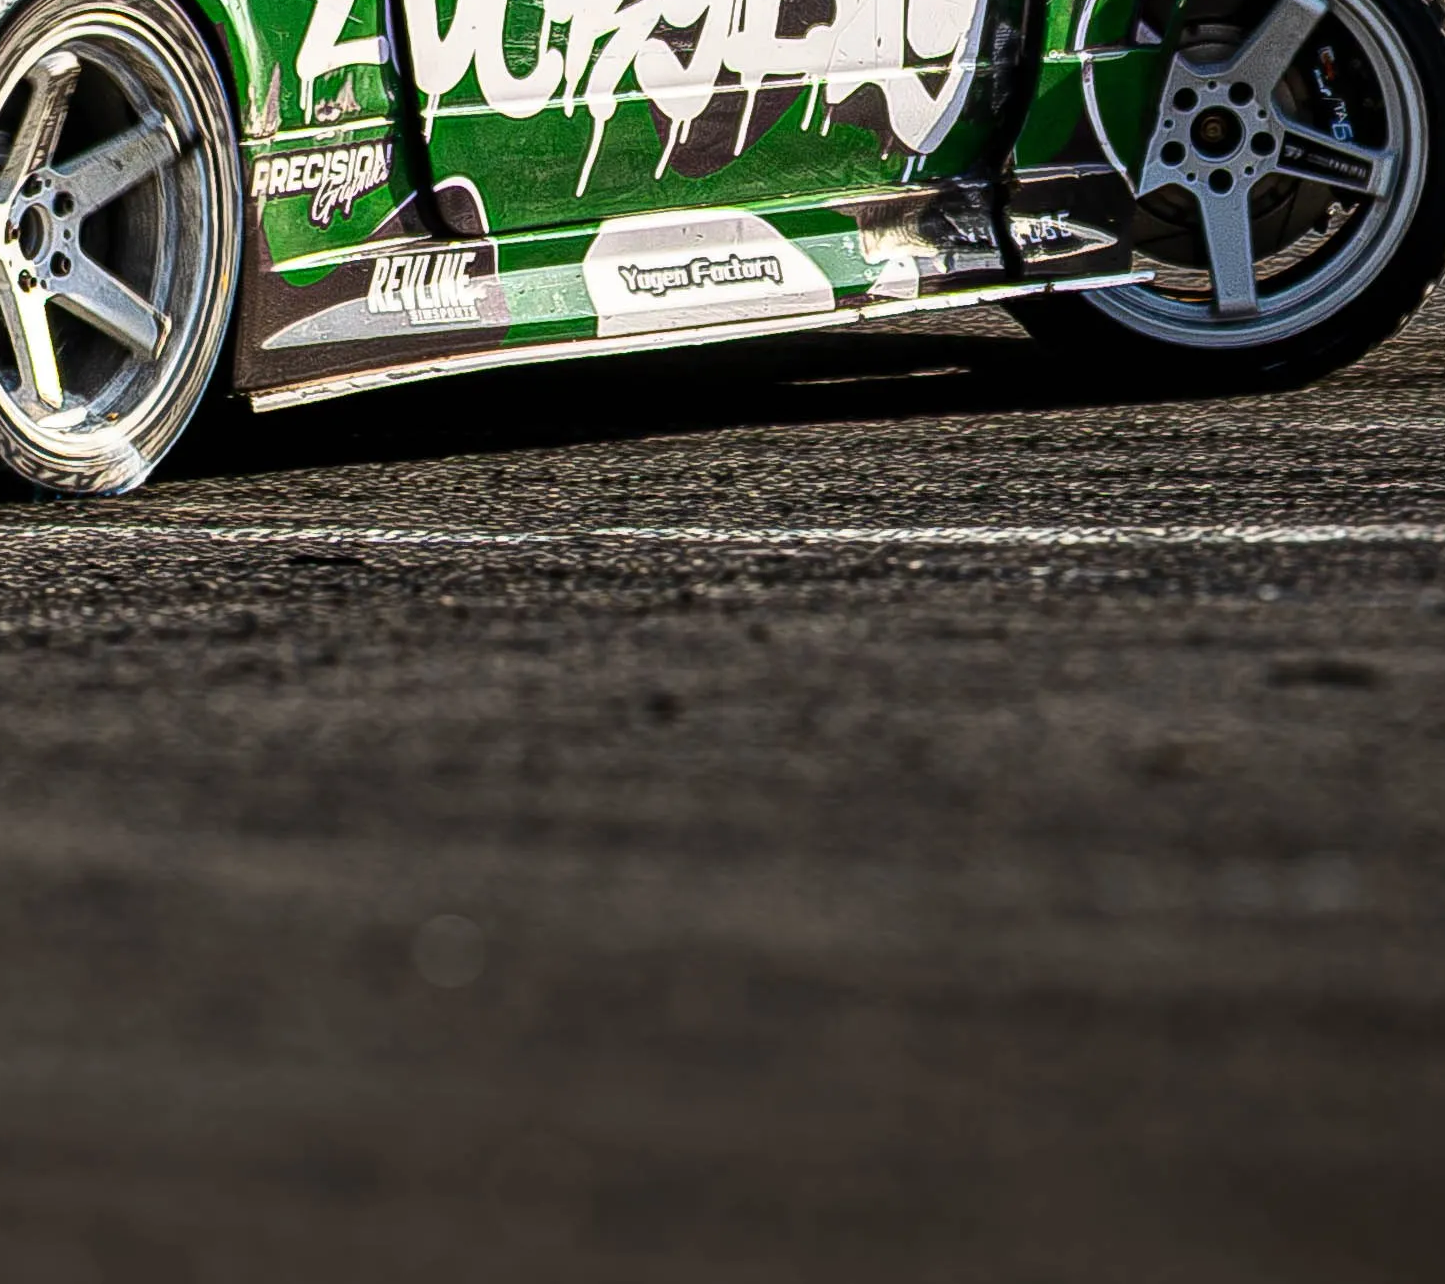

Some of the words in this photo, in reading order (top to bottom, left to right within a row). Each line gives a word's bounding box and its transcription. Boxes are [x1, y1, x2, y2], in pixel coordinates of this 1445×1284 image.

[250, 143, 394, 198] PRECISION
[367, 251, 478, 314] REVLINE
[689, 254, 784, 288] Factory
